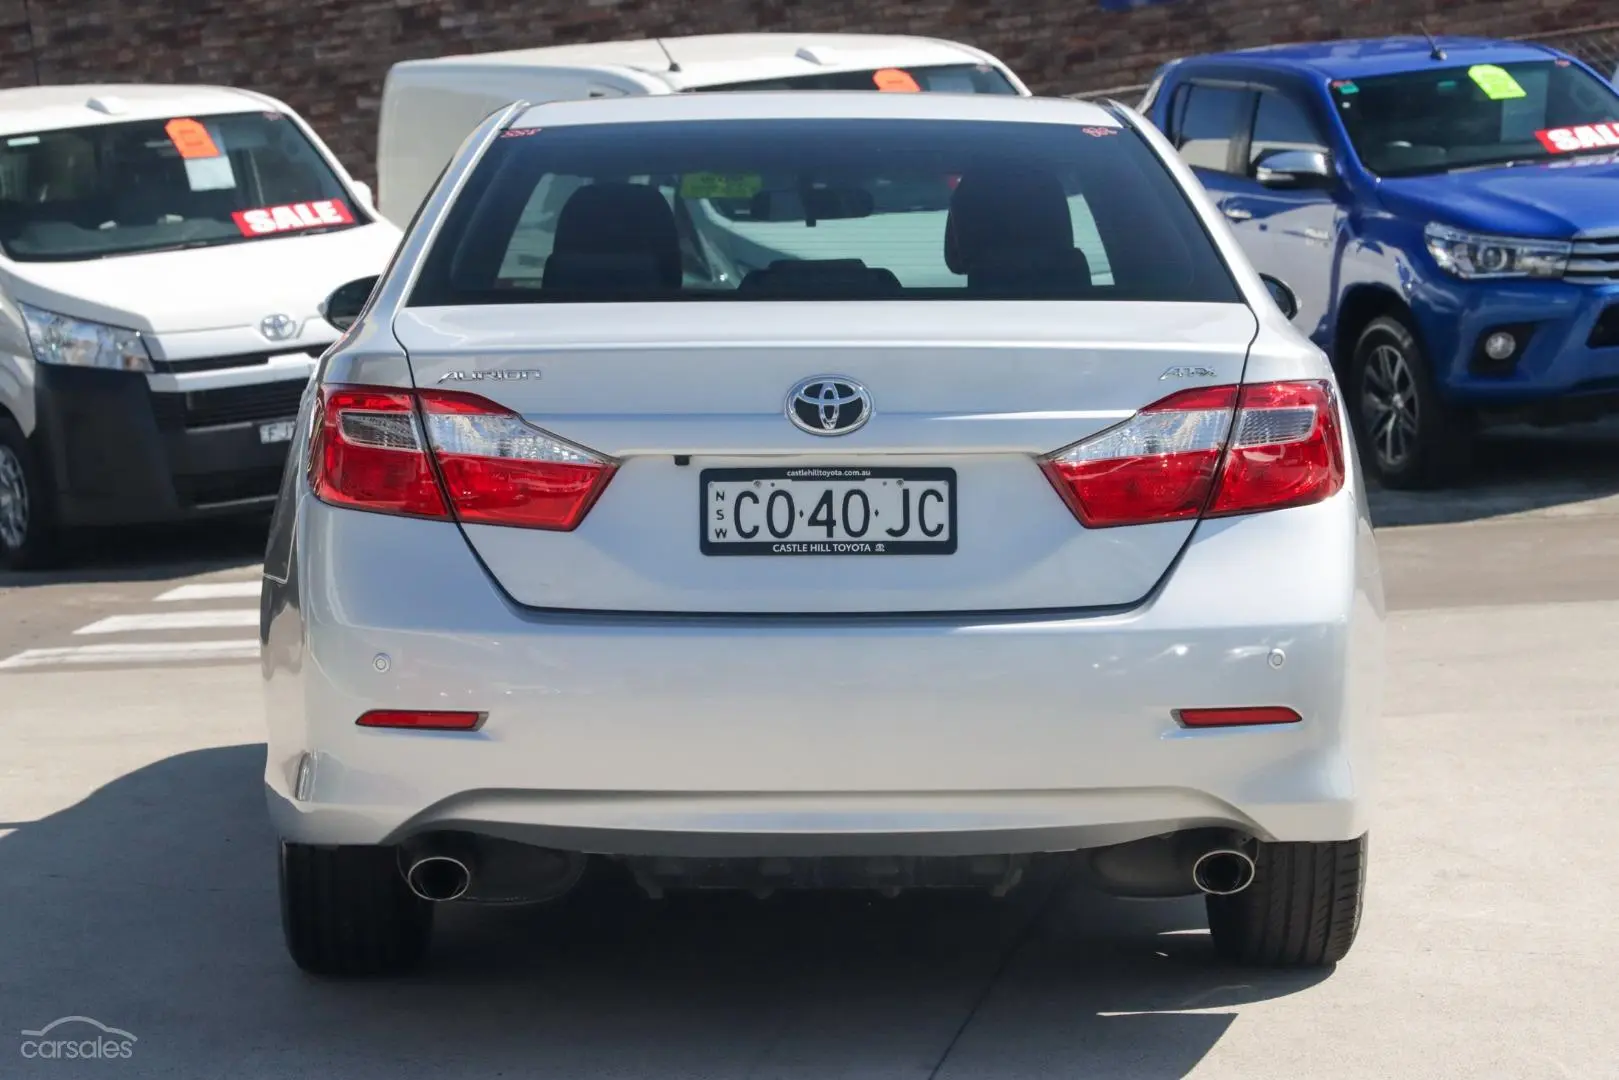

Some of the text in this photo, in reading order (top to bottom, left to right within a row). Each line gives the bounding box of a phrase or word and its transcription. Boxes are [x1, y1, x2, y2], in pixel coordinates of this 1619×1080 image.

[1547, 123, 1619, 151] SAL
[243, 200, 344, 233] SALE
[437, 369, 542, 384] AURION
[786, 469, 871, 478] castlehilltoyota.com.au
[772, 543, 871, 553] CASTLE HILL TOYOTA
